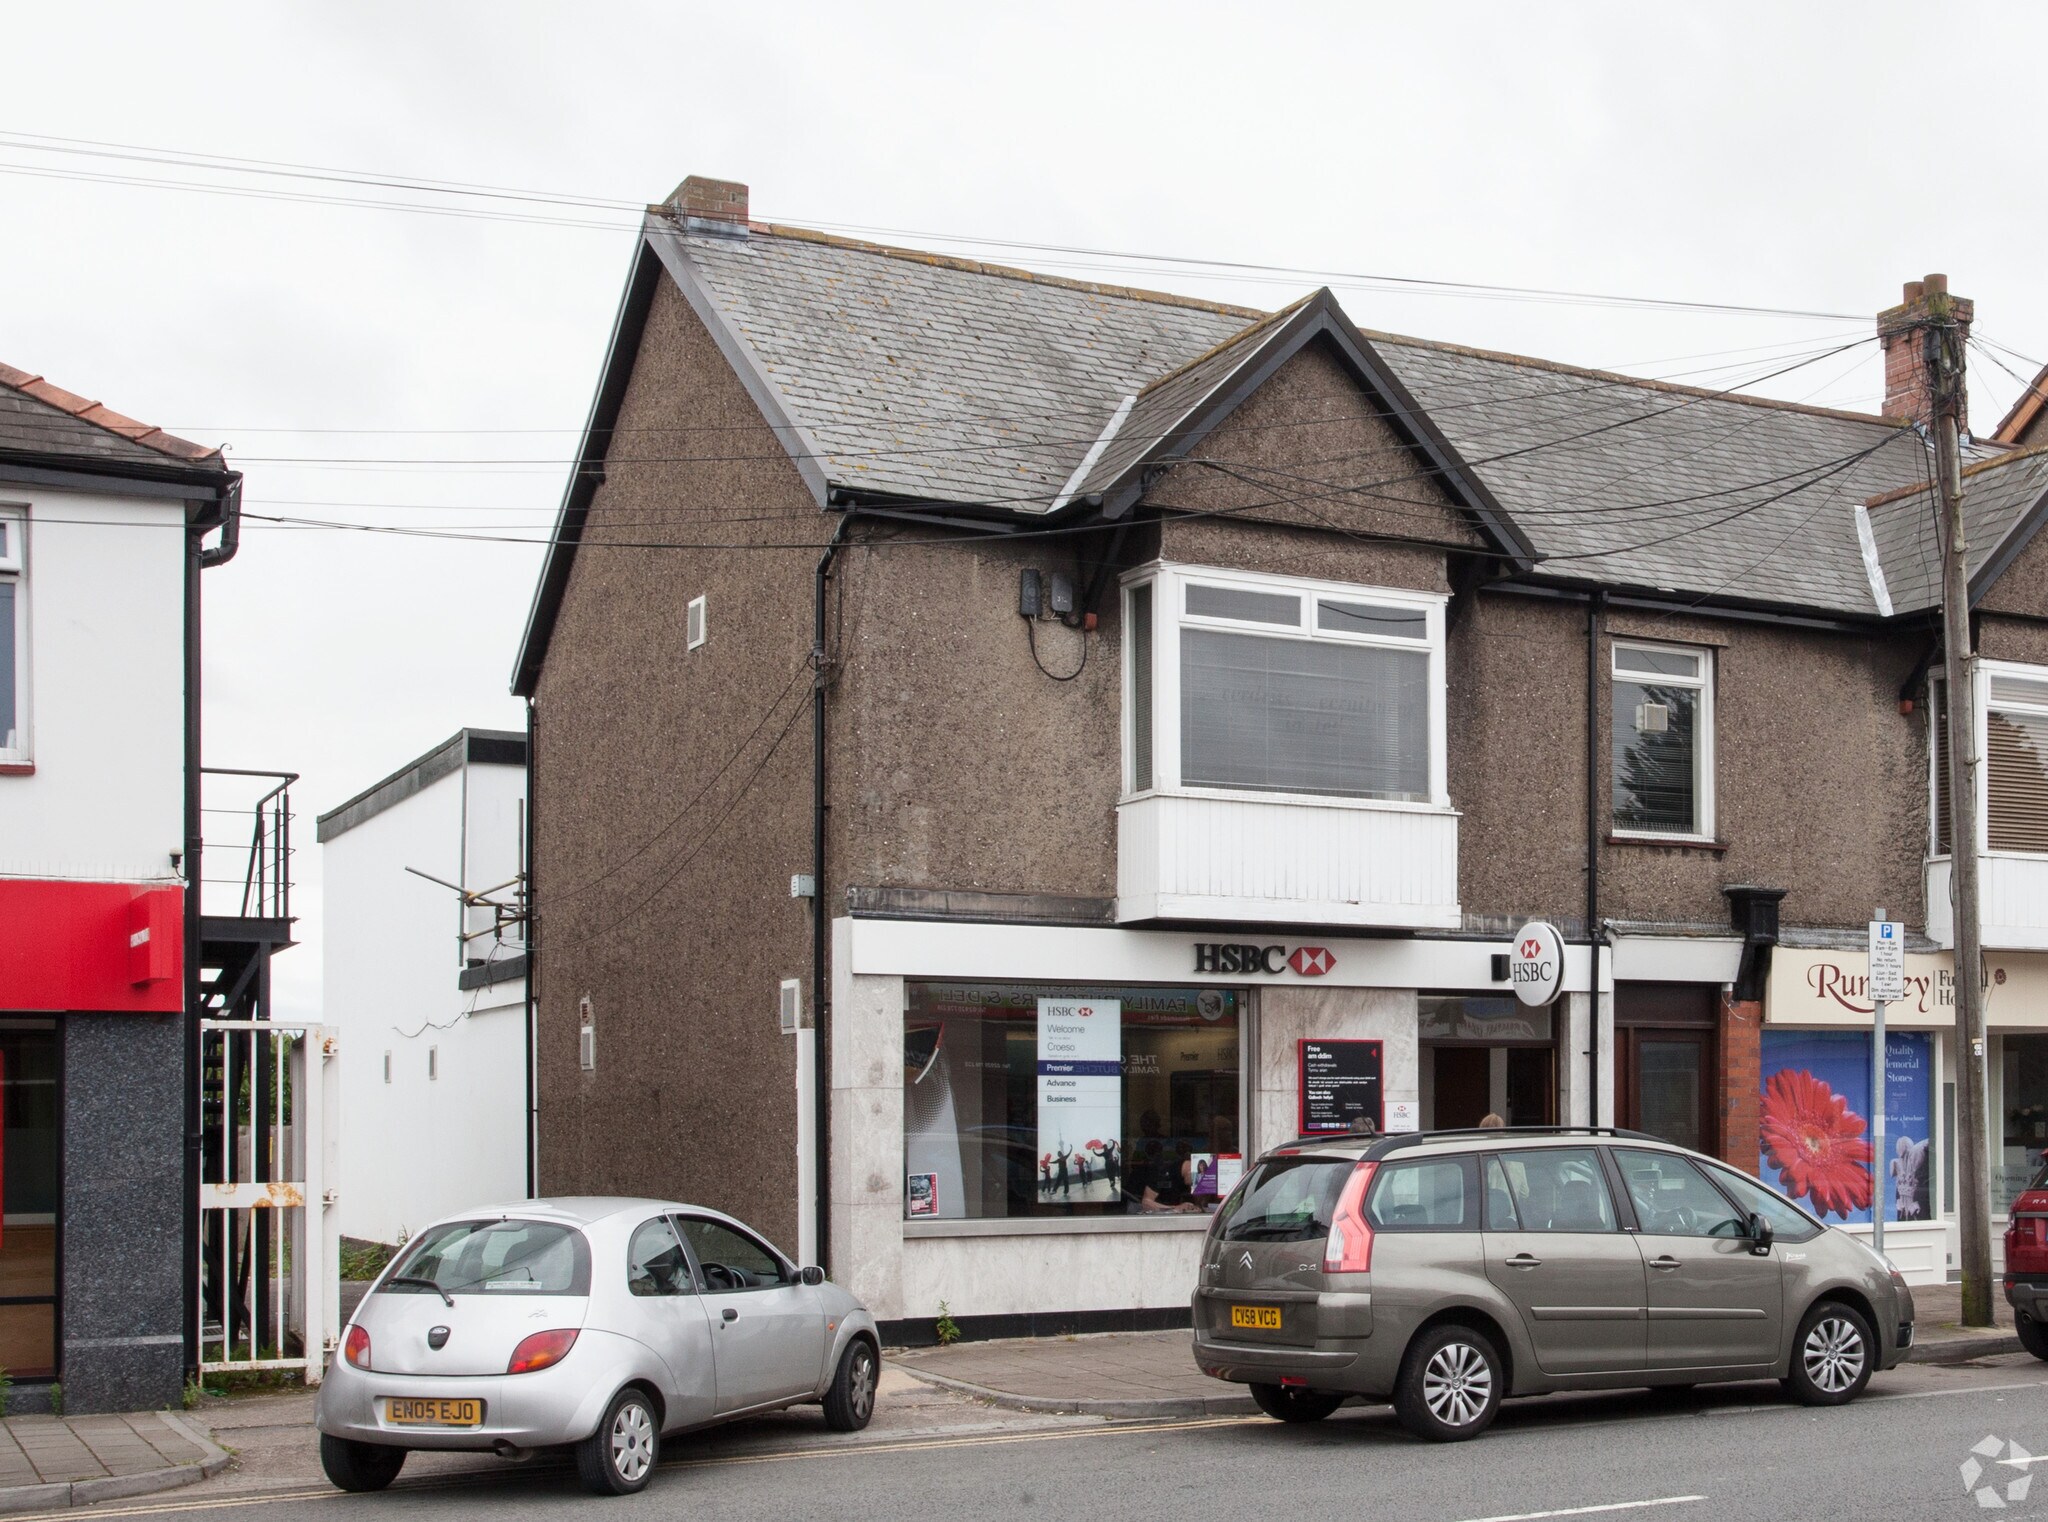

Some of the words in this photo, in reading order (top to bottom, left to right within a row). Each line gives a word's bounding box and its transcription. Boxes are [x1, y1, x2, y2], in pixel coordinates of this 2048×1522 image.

[1194, 943, 1286, 974] HSBC
[1513, 962, 1552, 983] HSBC
[1807, 964, 1930, 1013] Ruey
[1047, 1006, 1076, 1017] HSBC
[1047, 1024, 1086, 1034] Welcome
[1047, 1042, 1076, 1052] Croeso
[1307, 1045, 1321, 1053] Free
[1885, 1044, 1914, 1058] Quality
[1317, 1052, 1333, 1060] ddim
[1046, 1063, 1074, 1072] Premier
[1887, 1072, 1914, 1083] Stones
[1046, 1079, 1077, 1087] Advance
[1046, 1095, 1077, 1103] Business
[1393, 1111, 1411, 1119] HSBC
[1257, 1309, 1276, 1326] VCG
[392, 1401, 436, 1420] EN05
